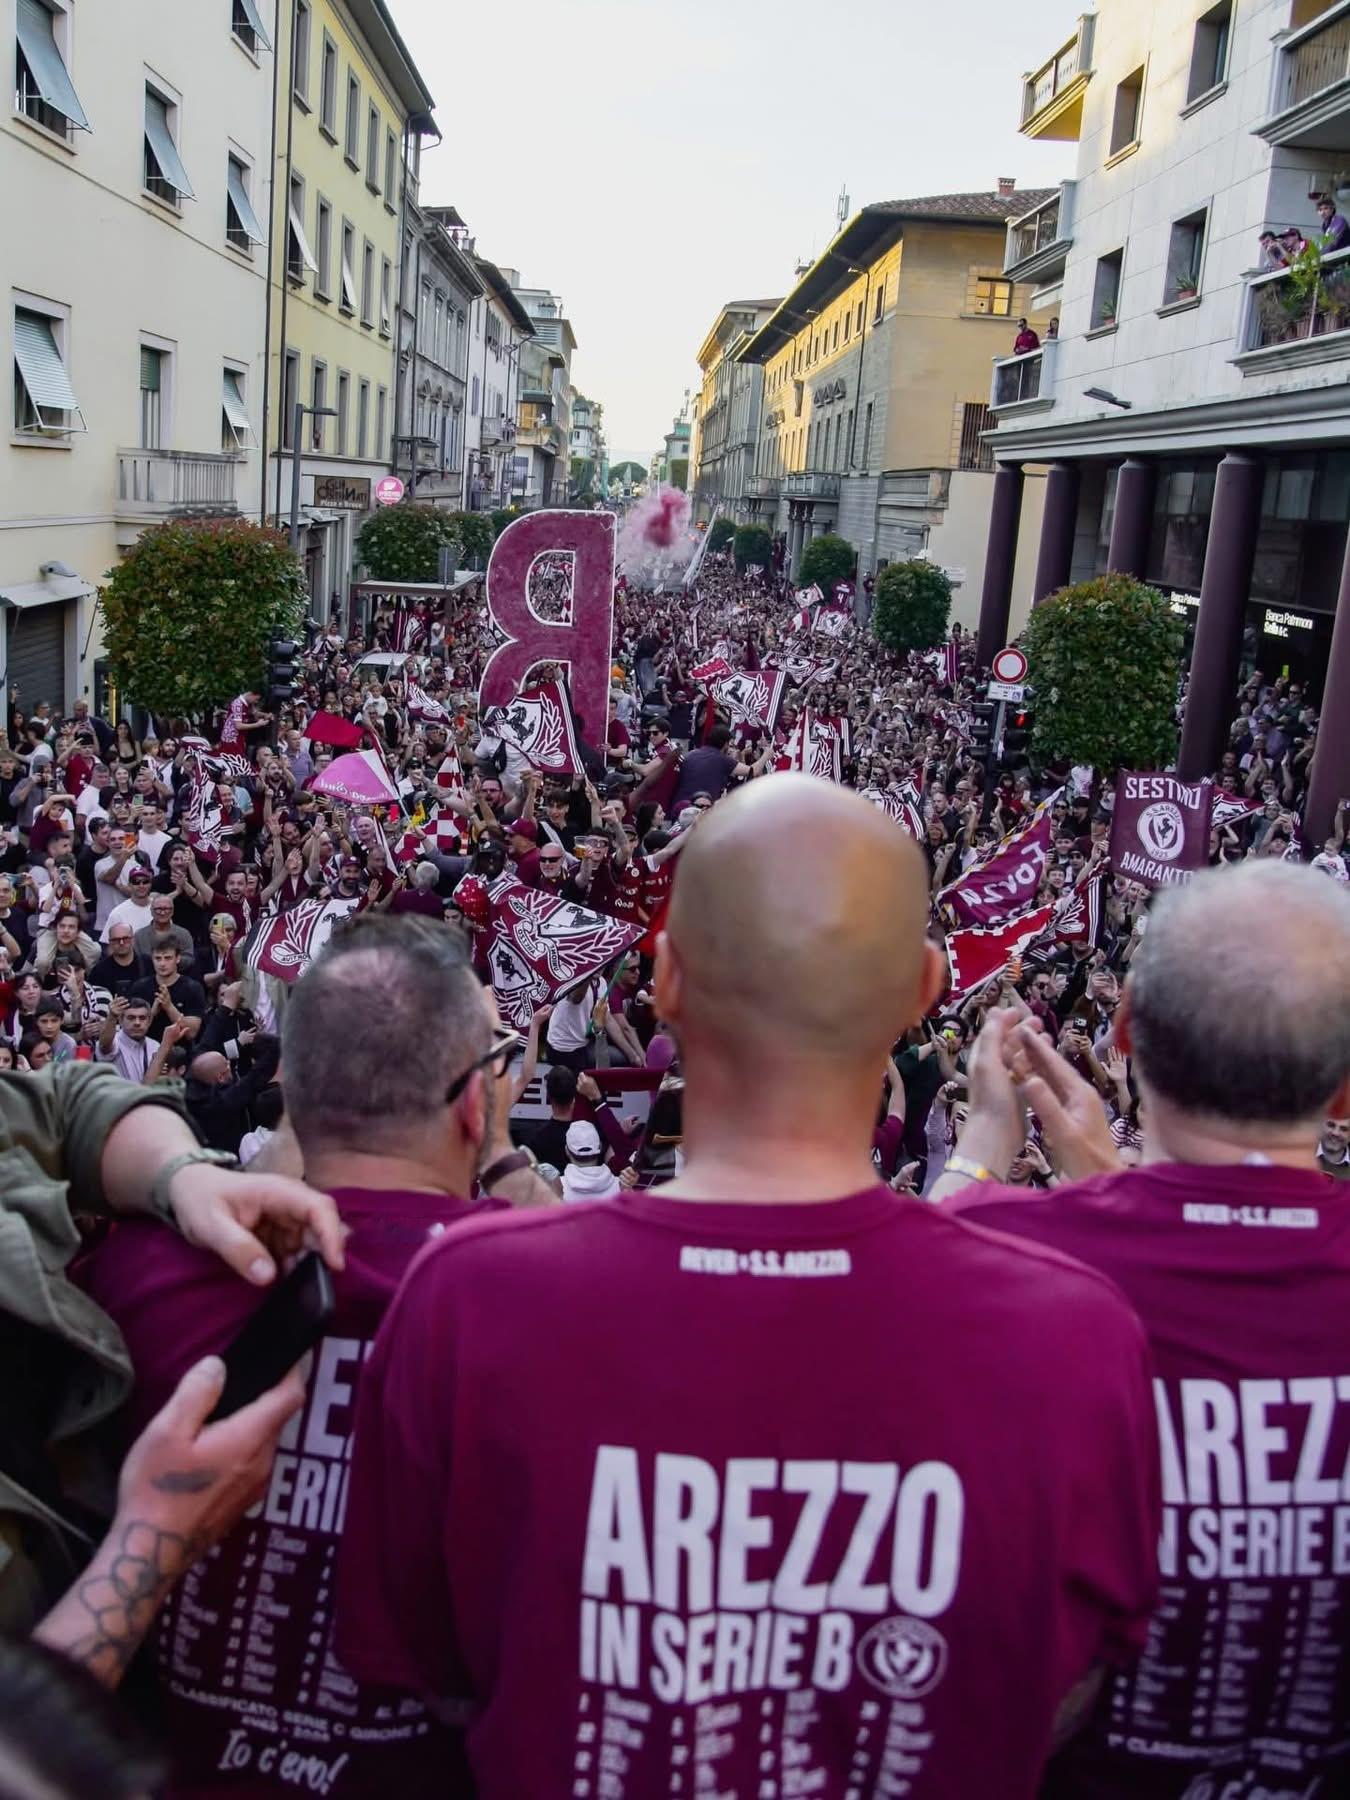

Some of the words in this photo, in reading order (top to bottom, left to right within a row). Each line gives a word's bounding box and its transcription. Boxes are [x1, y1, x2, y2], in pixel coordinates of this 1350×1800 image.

[1265, 609, 1284, 624] Banca
[1284, 612, 1313, 630] Patrimoni
[581, 1444, 964, 1618] AREZZO
[1187, 1507, 1324, 1579] SERIE
[579, 1598, 640, 1690] IN
[650, 1609, 808, 1705] SERIE
[812, 1611, 855, 1691] B
[217, 1729, 251, 1770] Io
[258, 1739, 349, 1796] c'ero!
